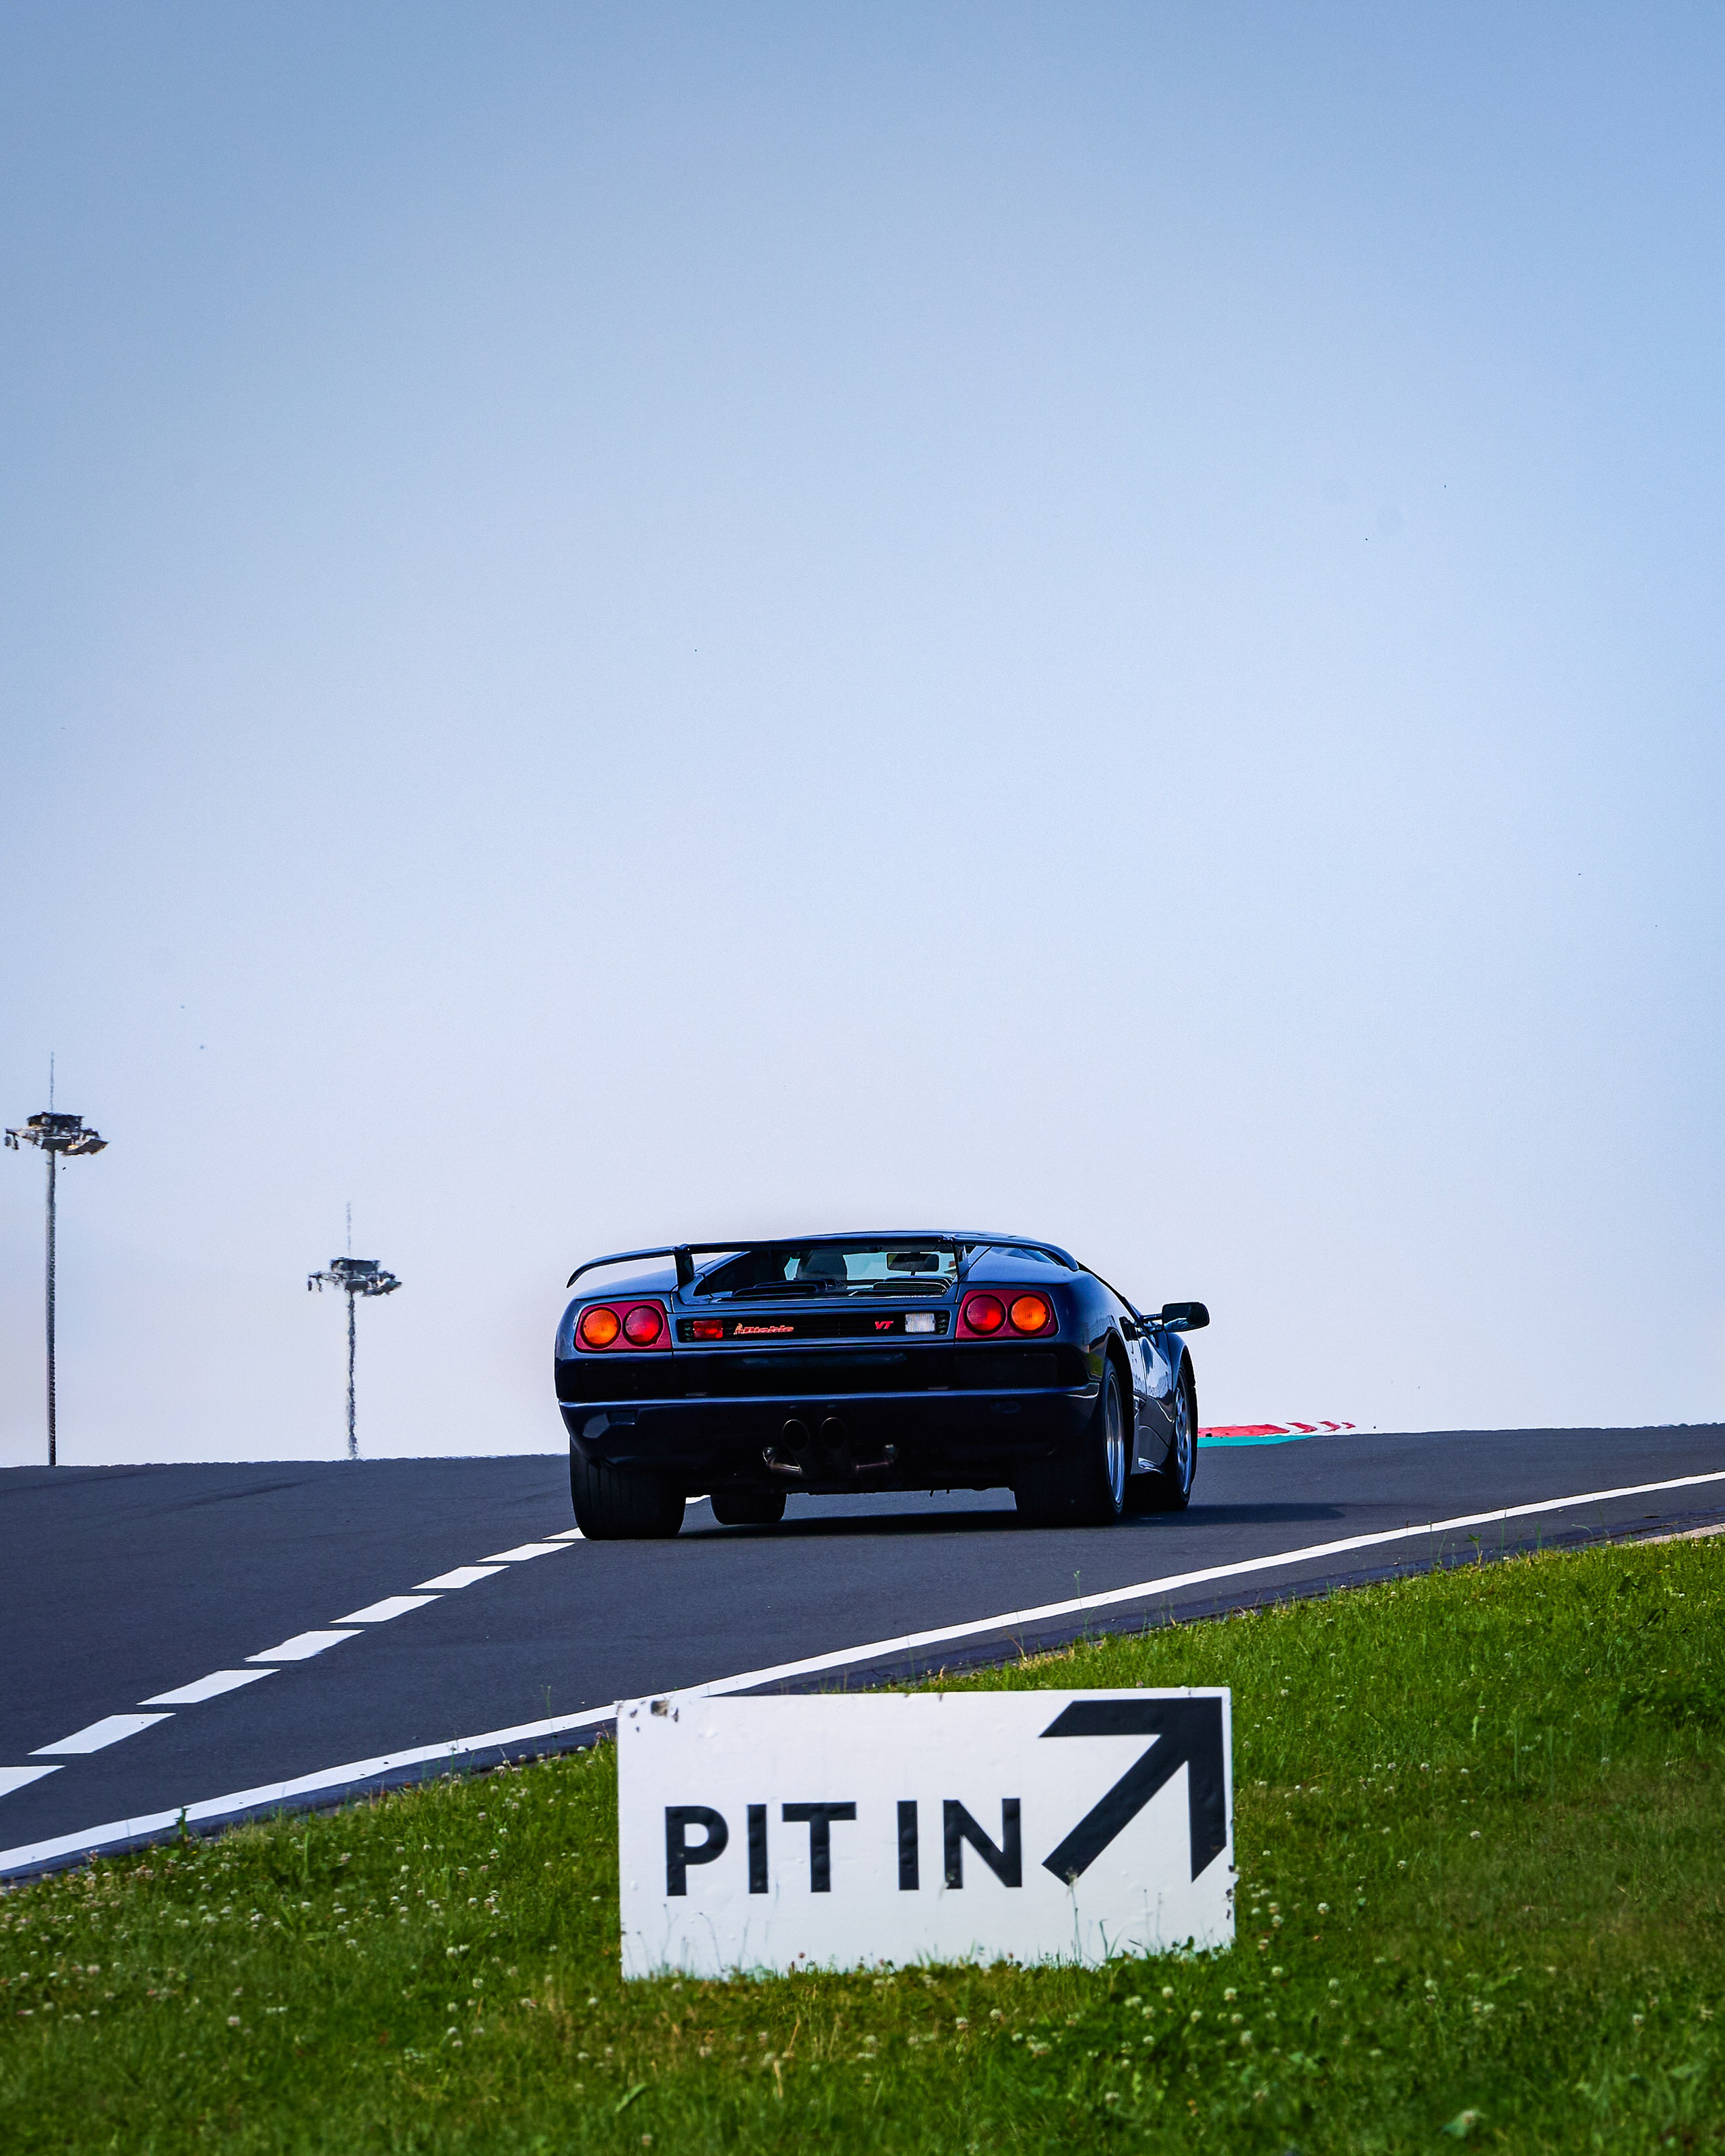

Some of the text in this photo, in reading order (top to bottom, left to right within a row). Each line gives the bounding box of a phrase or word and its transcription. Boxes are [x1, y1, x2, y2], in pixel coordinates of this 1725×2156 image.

[875, 1321, 894, 1329] VT
[665, 1798, 1022, 1896] PIT IN
